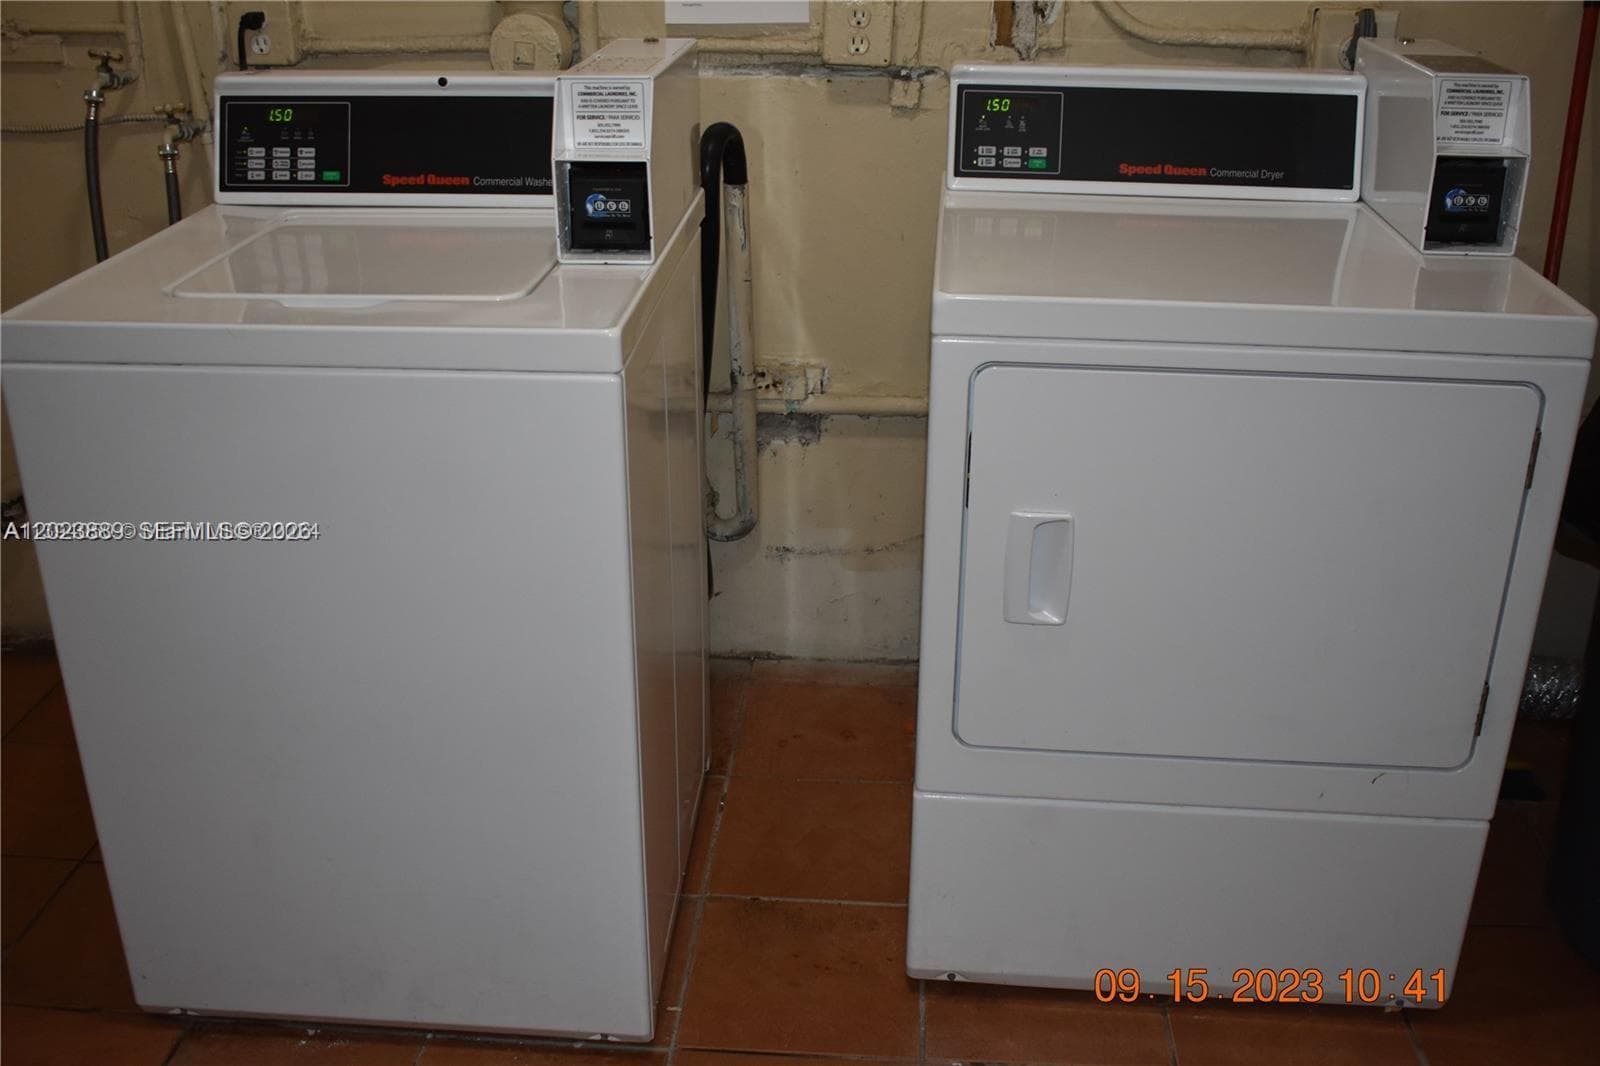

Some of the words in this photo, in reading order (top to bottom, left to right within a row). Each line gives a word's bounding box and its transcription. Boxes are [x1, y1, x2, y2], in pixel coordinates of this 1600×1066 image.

[382, 173, 424, 187] Speed
[427, 174, 470, 186] Queen
[473, 175, 523, 187] Commercial
[525, 176, 553, 187] Washe
[1119, 163, 1161, 177] Speed
[1163, 164, 1206, 176] Queen
[1209, 167, 1258, 178] Commercial
[1260, 169, 1285, 181] Dryer
